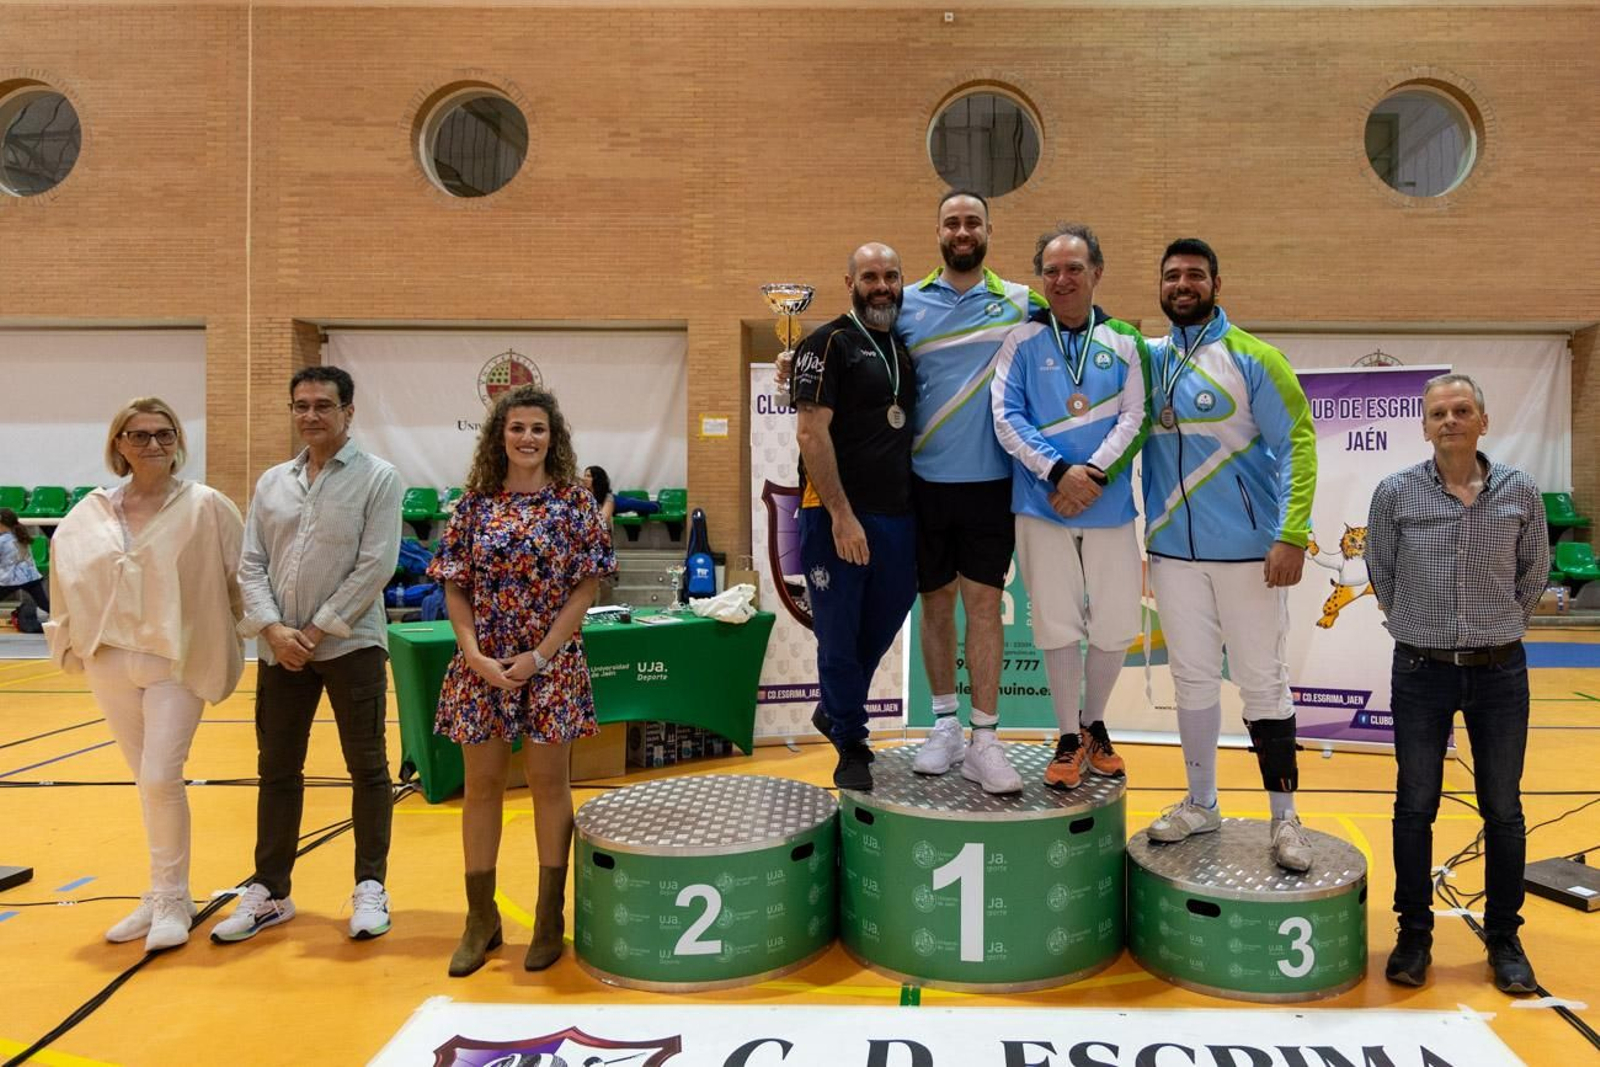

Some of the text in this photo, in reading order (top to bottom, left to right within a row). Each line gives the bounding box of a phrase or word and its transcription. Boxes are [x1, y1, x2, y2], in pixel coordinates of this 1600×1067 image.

[1340, 399, 1361, 418] DE
[1345, 426, 1388, 451] JAÉN
[1016, 660, 1040, 670] 777
[674, 884, 721, 955] 2
[932, 843, 984, 962] 1
[1278, 917, 1315, 978] 3
